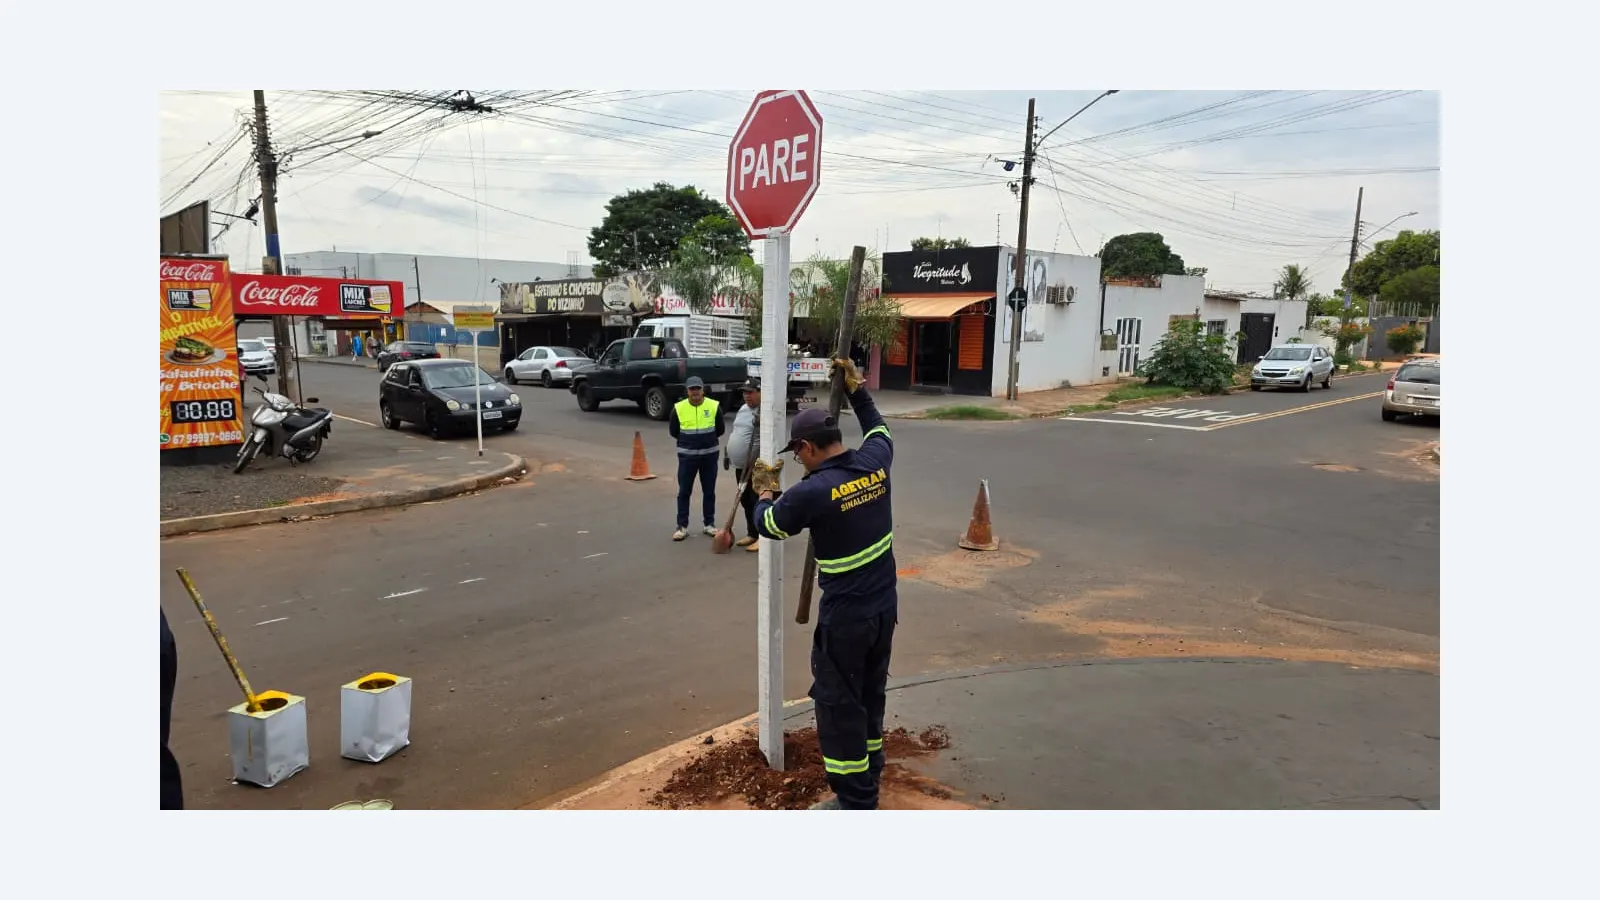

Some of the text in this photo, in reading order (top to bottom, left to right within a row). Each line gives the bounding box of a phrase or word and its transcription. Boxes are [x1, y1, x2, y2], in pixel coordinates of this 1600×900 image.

[740, 135, 808, 191] PARE
[160, 261, 216, 281] Coca-Cola
[913, 265, 960, 282] Negritude
[171, 291, 189, 301] MIX
[240, 281, 322, 307] Coca-Cola
[344, 287, 365, 300] MIX
[563, 282, 568, 296] E
[548, 298, 557, 310] DO
[170, 311, 182, 323] O
[787, 361, 824, 371] getran
[179, 379, 238, 391] Brioche
[831, 468, 887, 501] AGETRAN
[840, 486, 887, 512] SINALIZAÇÃO
